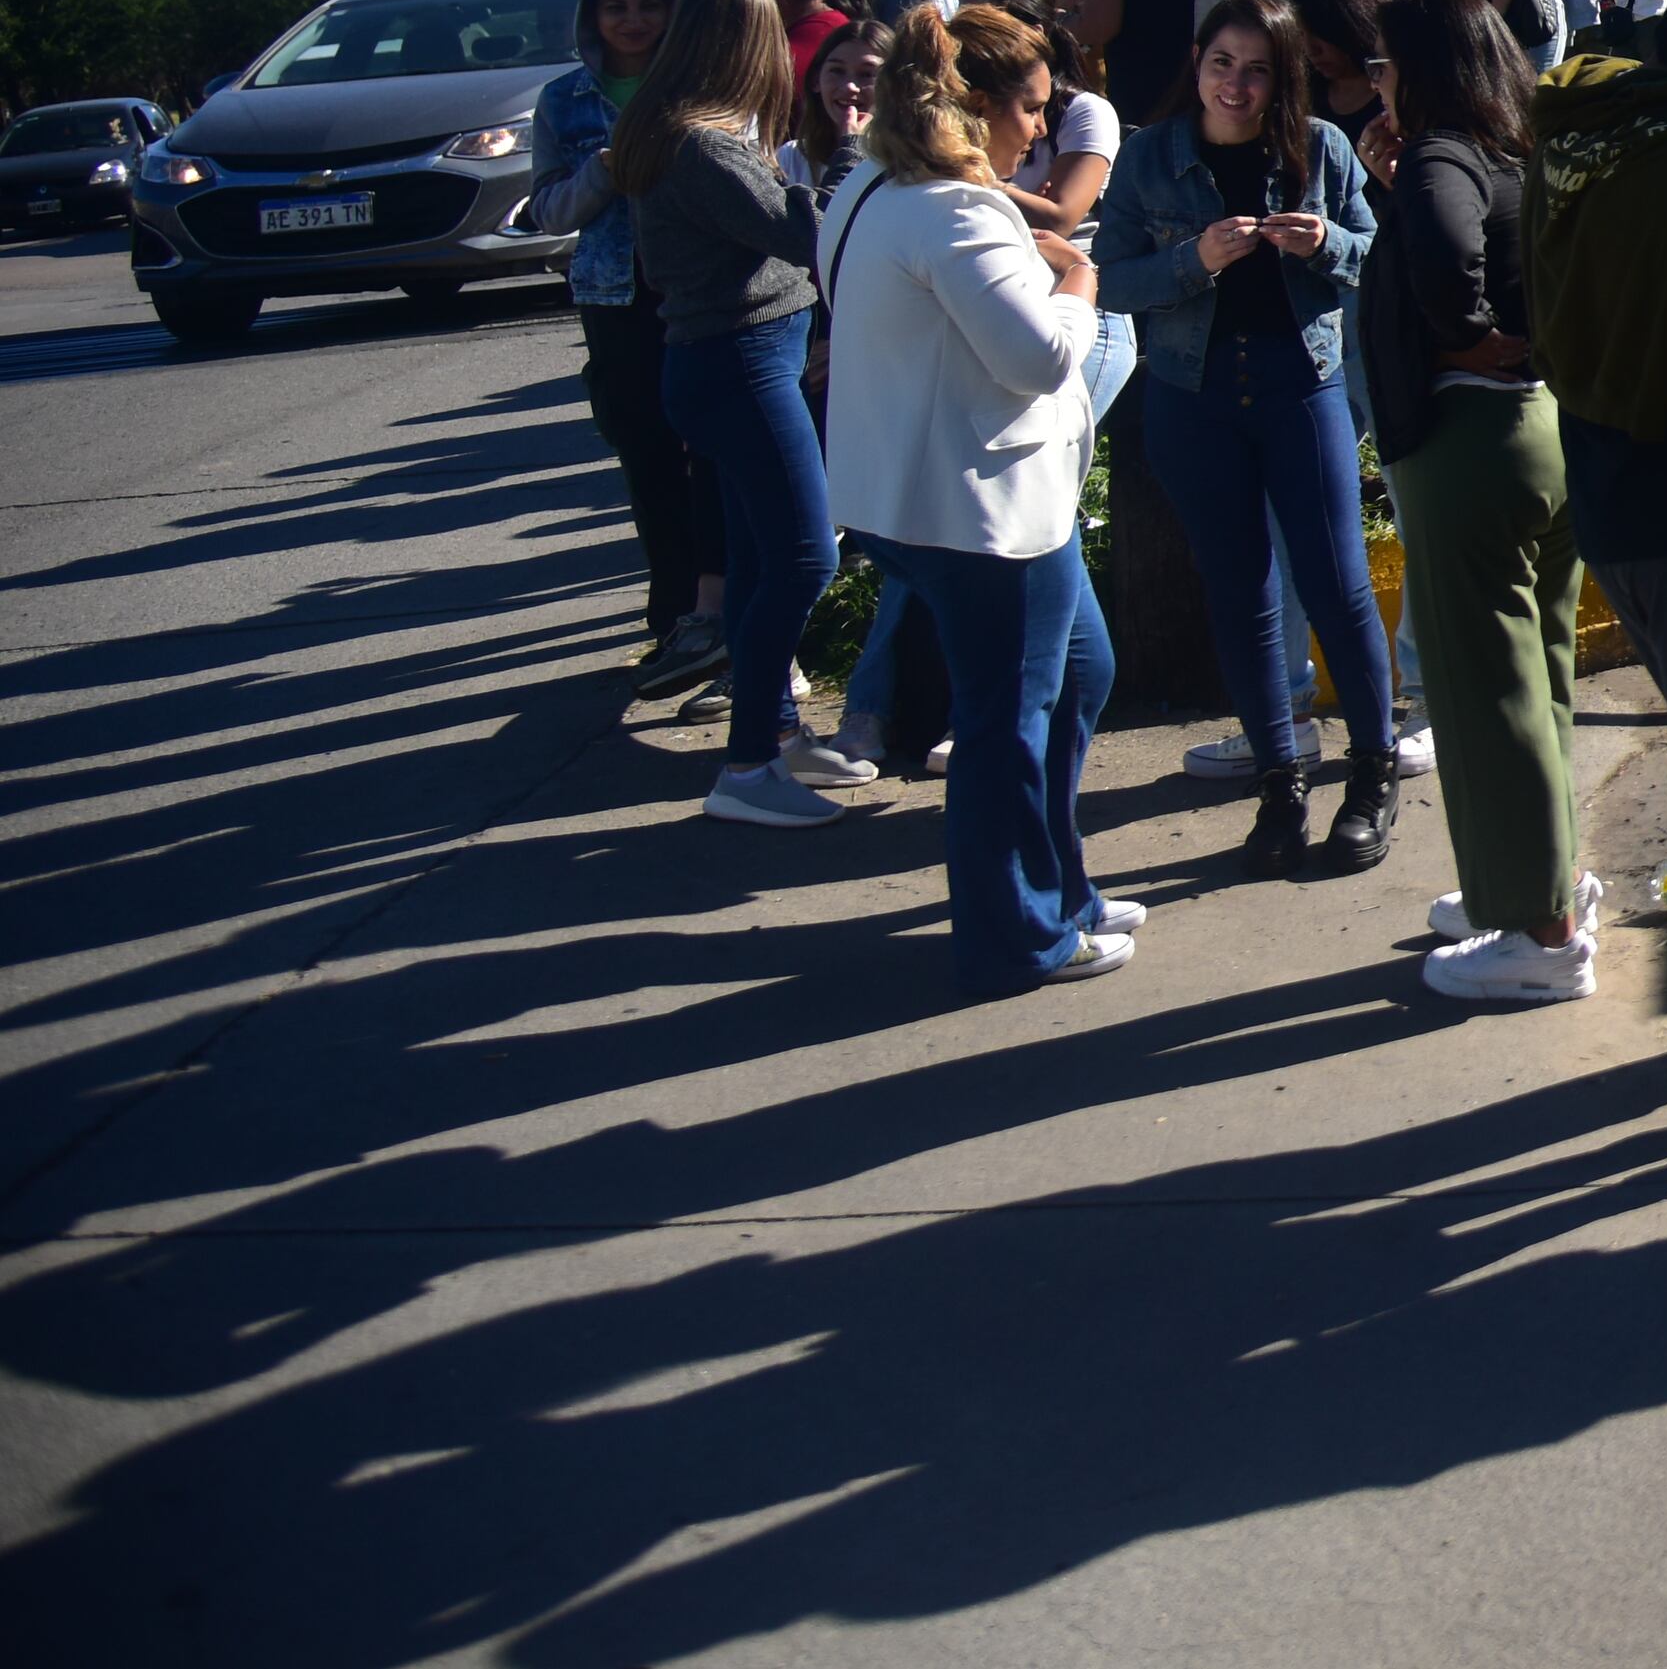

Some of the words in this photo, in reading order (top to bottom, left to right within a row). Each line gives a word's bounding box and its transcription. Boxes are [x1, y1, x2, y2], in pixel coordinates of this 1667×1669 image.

[267, 210, 290, 230] AE
[298, 206, 335, 228] 391
[342, 203, 366, 223] TN
